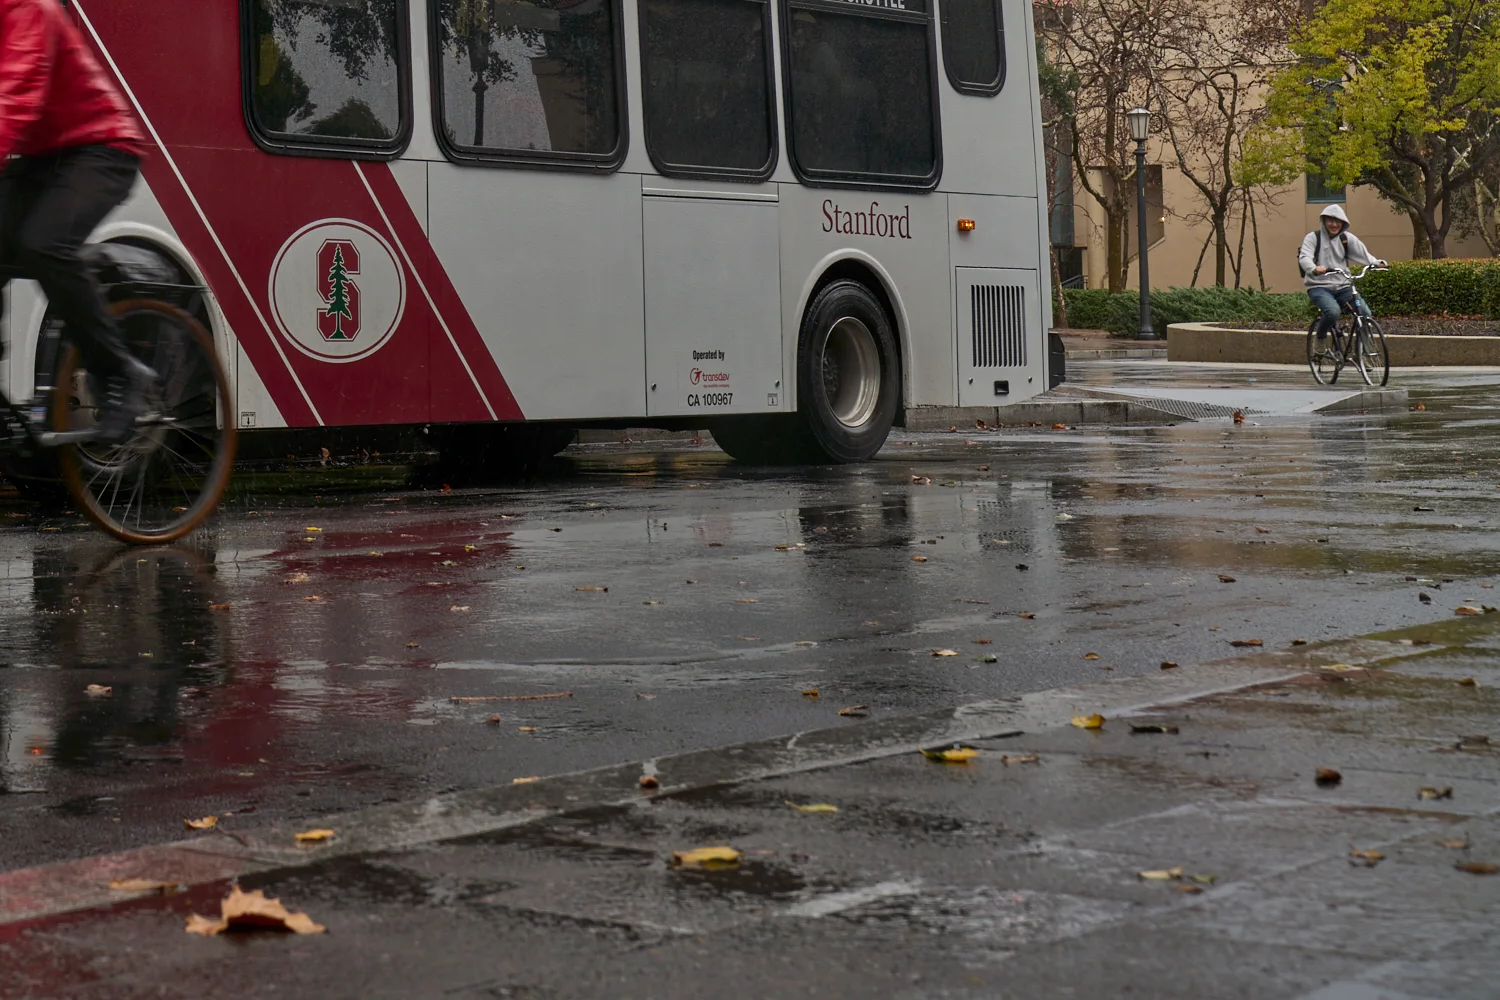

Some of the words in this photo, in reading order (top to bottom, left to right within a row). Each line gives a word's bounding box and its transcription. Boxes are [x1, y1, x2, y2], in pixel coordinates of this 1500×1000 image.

[822, 199, 912, 239] Stanford
[692, 350, 717, 361] Operated
[718, 350, 725, 361] by
[702, 372, 730, 381] transdev
[687, 394, 701, 407] CA
[702, 392, 733, 406] 100967
